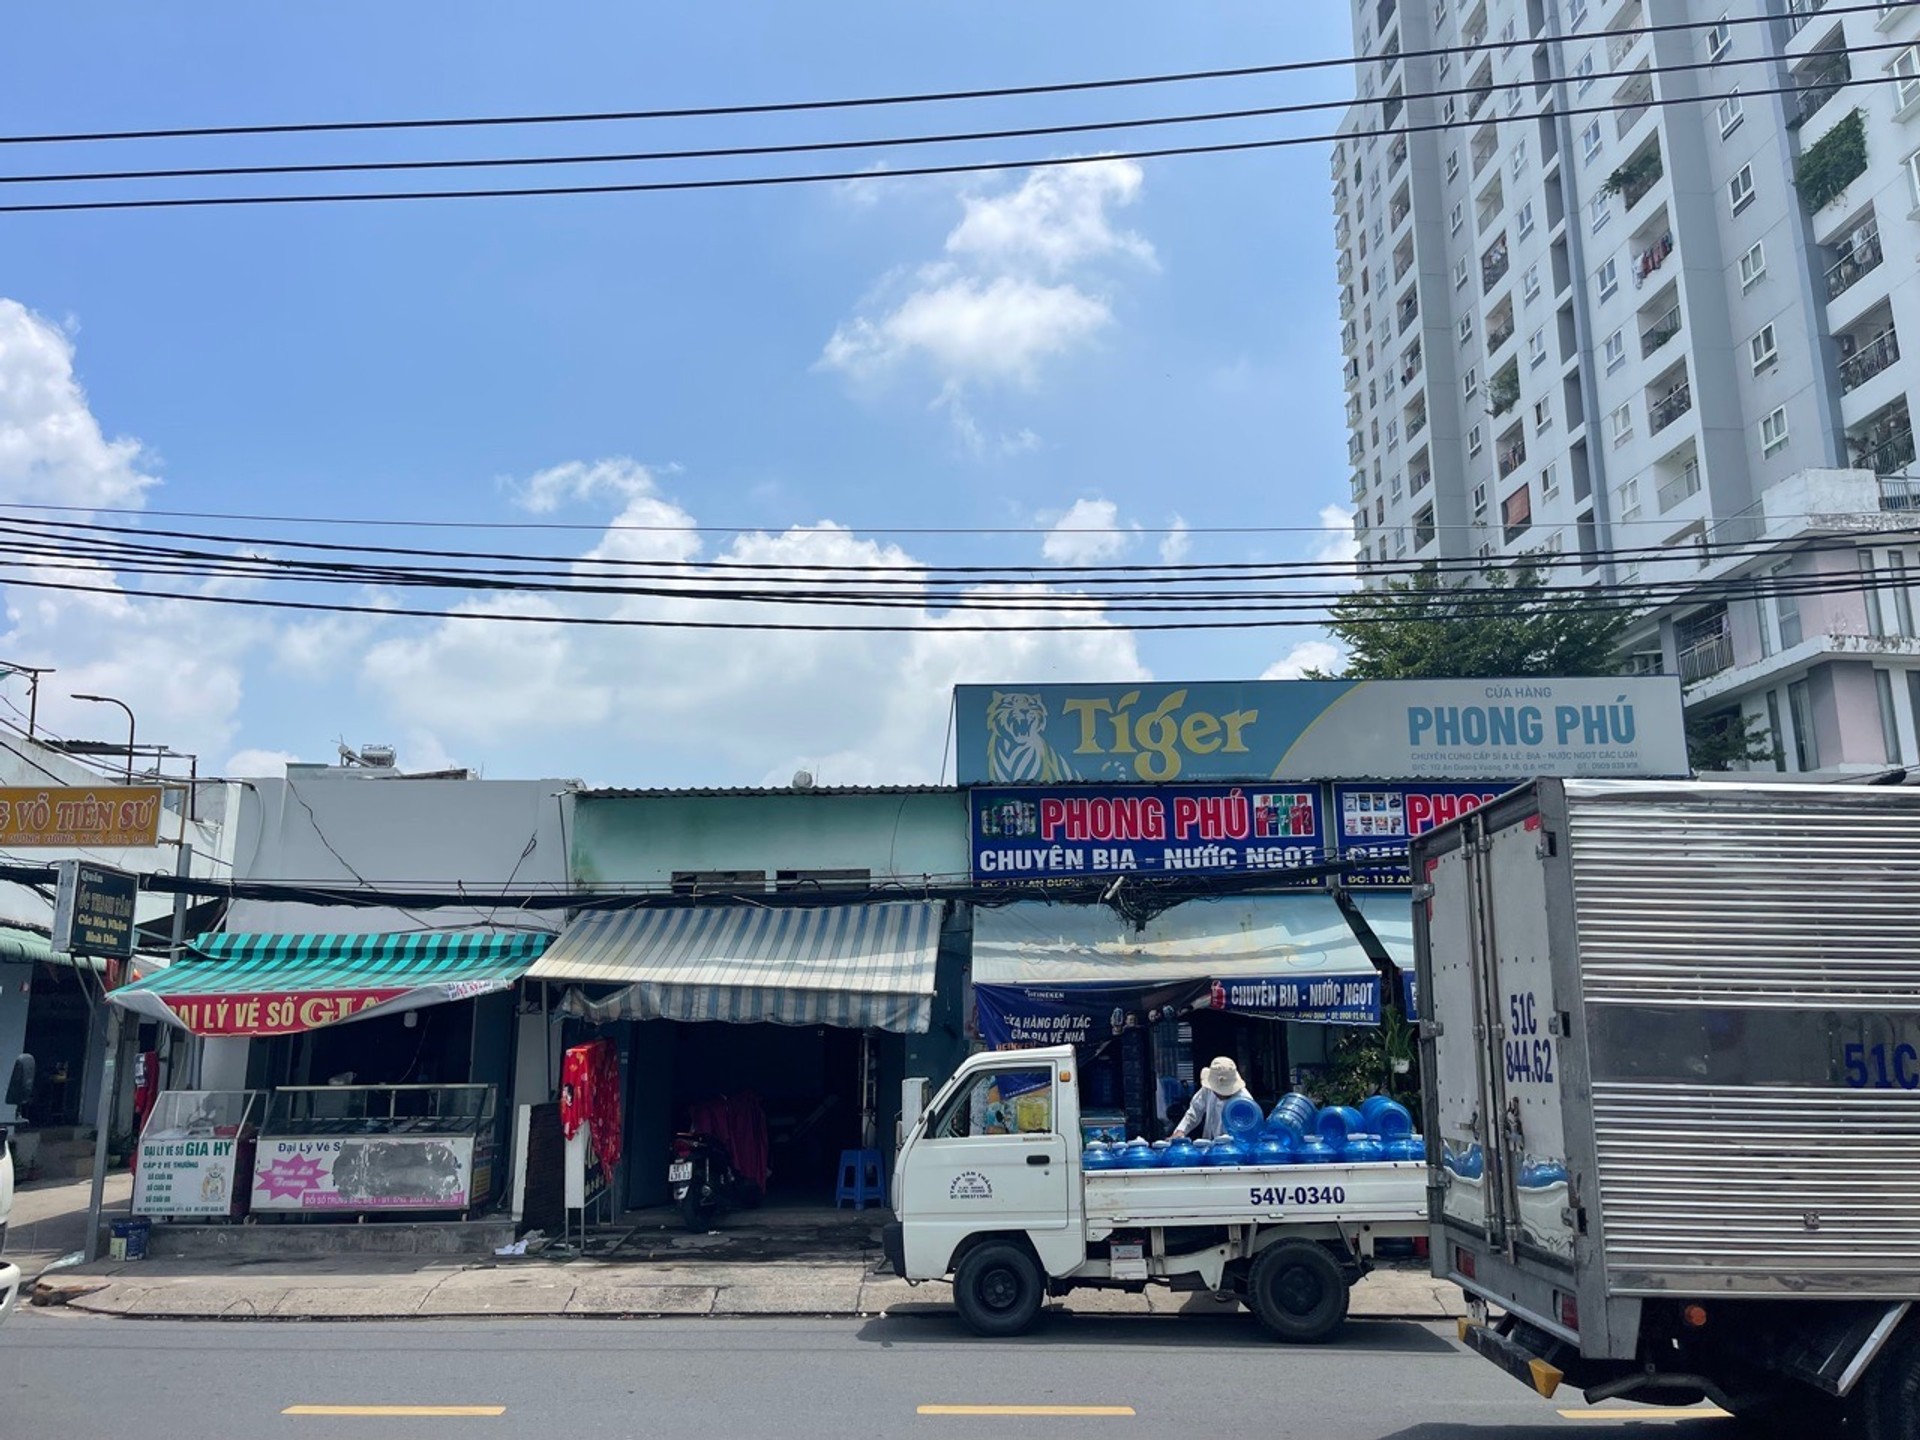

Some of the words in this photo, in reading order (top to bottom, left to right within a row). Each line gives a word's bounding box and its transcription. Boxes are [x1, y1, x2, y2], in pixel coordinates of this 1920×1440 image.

[1515, 685, 1552, 698] HÀNG
[1062, 689, 1259, 781] Tiger
[1408, 706, 1544, 746] PHONG
[1555, 694, 1636, 745] PHÚ
[15, 792, 50, 831] VÕ
[55, 792, 116, 831] TIÊN
[118, 795, 157, 831] SƯ
[1041, 796, 1166, 841] PHONG
[1173, 787, 1250, 841] PHÚ
[979, 844, 1084, 871] CHUYÊN
[1092, 848, 1138, 870] BIA
[1163, 843, 1237, 870] NƯỚC
[1373, 875, 1394, 883] 112
[1231, 980, 1276, 1007] CHUYÊN
[1279, 984, 1299, 1007] BIA
[1309, 979, 1341, 1007] NƯỚC
[1343, 982, 1373, 1010] NGỌT
[204, 998, 230, 1029] LÝ
[235, 997, 260, 1028] VÉ
[265, 996, 298, 1027] SỐ
[1022, 1014, 1052, 1028] HÀNG
[1052, 1014, 1071, 1028] ĐỐI
[1072, 1014, 1092, 1028] TÁC
[1510, 991, 1537, 1036] 51C
[1064, 1030, 1086, 1042] NHÀ
[1505, 1039, 1553, 1083] 844.62
[1845, 1043, 1919, 1090] 51C
[185, 1142, 209, 1156] GIA
[213, 1142, 232, 1156] HY
[278, 1142, 297, 1154] Đại
[299, 1141, 313, 1154] Lý
[316, 1142, 330, 1152] Vé
[1249, 1186, 1346, 1206] 54V-0340
